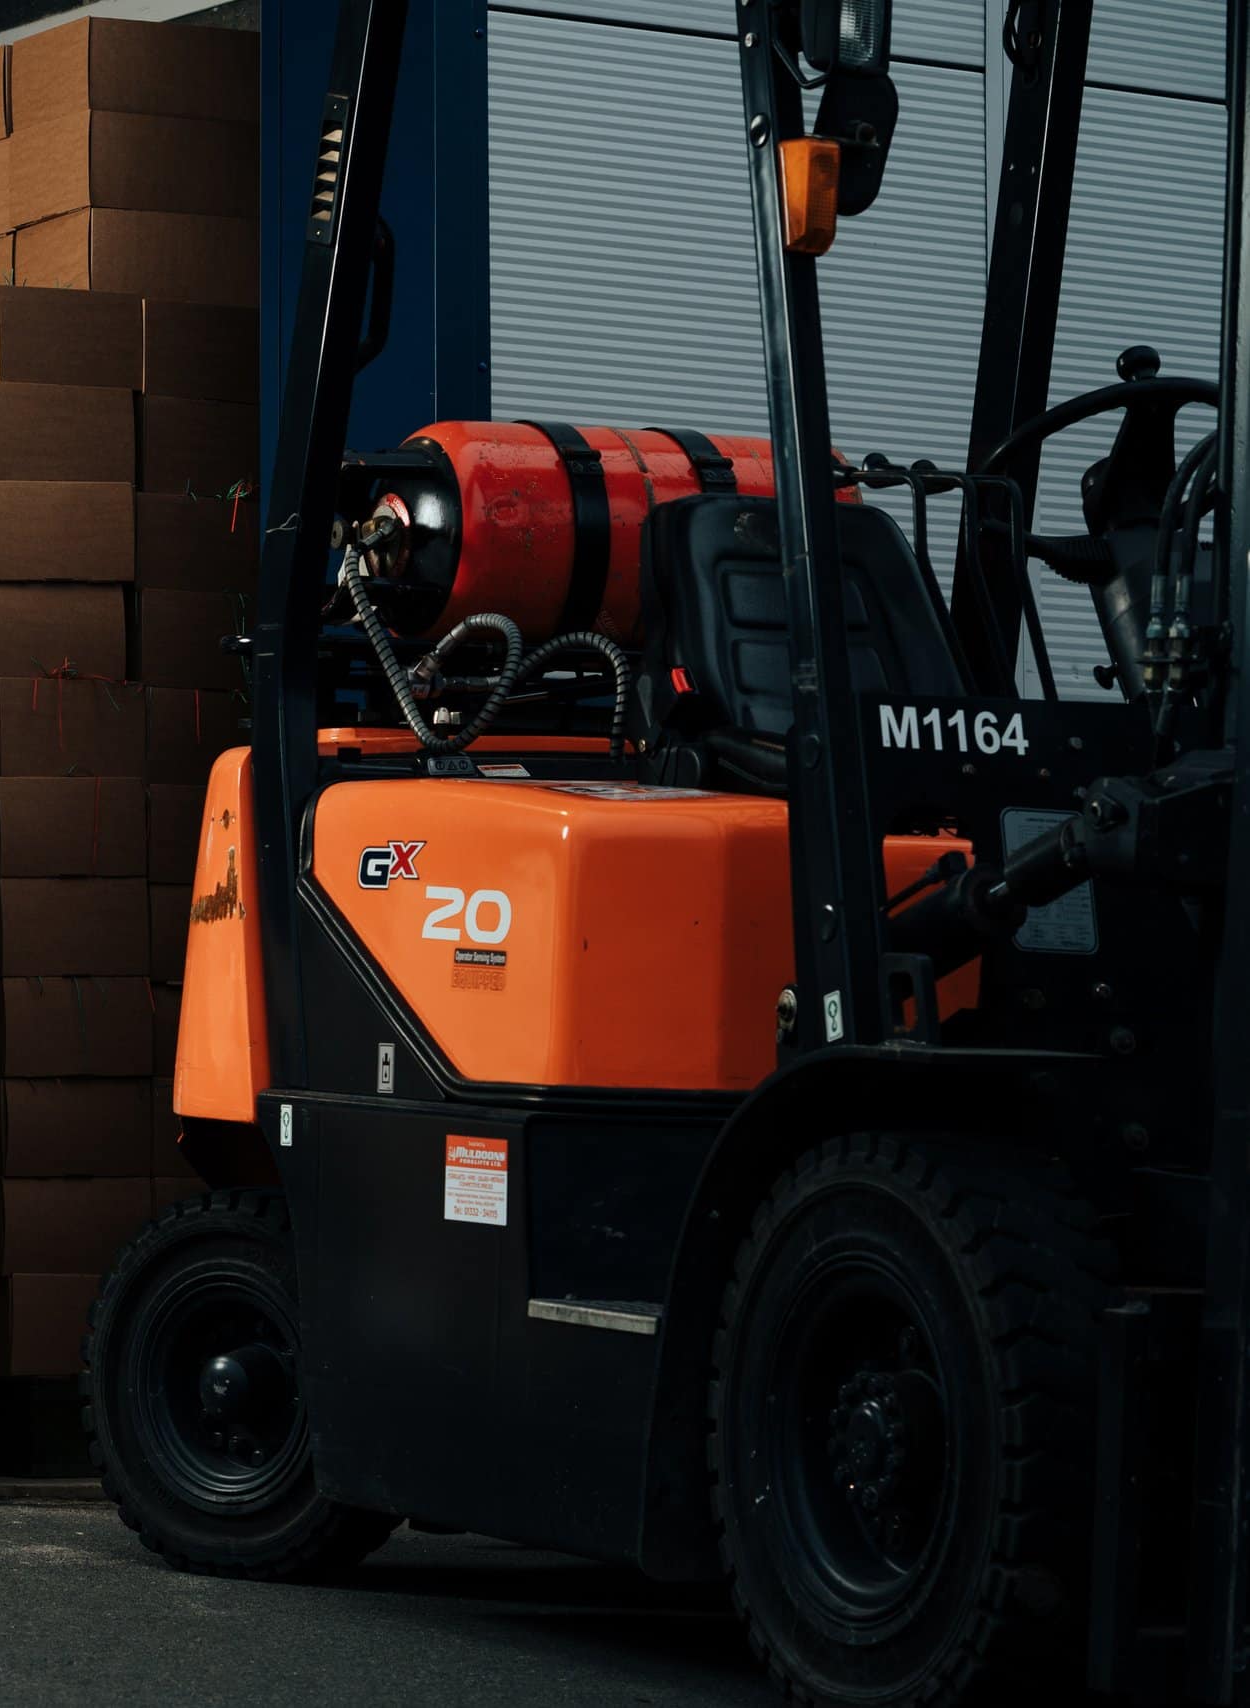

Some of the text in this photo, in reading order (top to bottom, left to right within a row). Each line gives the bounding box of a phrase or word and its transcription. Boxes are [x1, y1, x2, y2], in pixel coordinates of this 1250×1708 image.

[879, 704, 1029, 755] M1164
[358, 840, 427, 890] GX
[422, 886, 511, 944] 20
